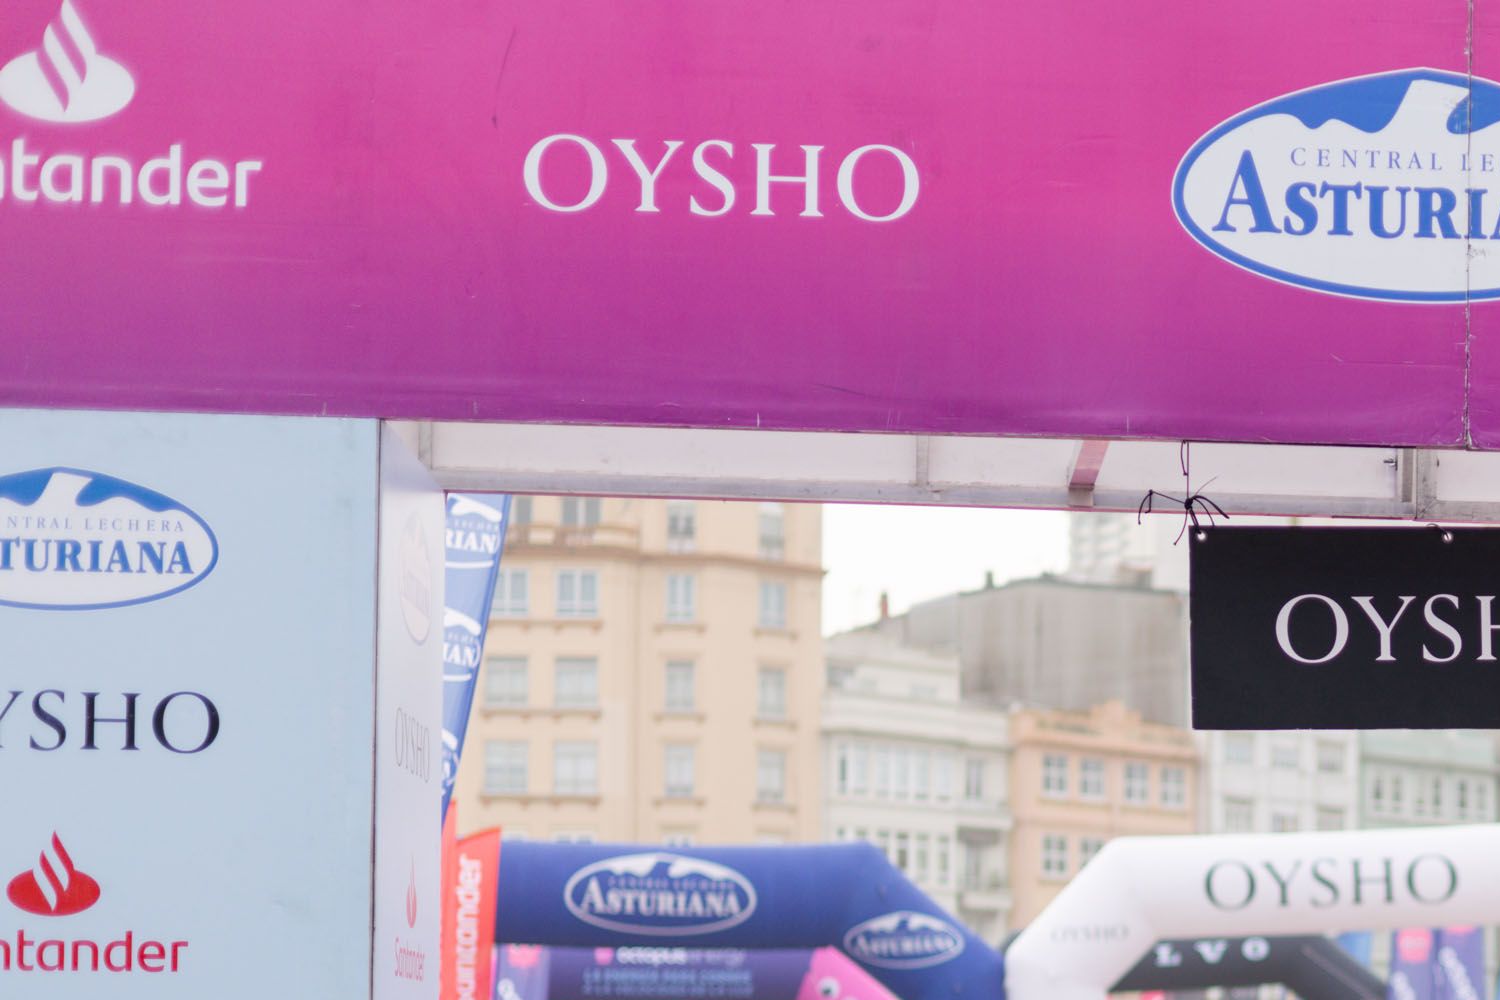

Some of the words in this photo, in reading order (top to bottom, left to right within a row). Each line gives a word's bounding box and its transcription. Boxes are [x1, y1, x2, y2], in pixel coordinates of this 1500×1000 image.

[0, 138, 262, 207] tander
[523, 133, 920, 222] OYSHO
[1290, 146, 1443, 171] CENTRAL
[83, 516, 185, 533] LECHERA
[394, 706, 432, 784] OYSHO
[579, 875, 743, 918] ASTURIANA
[1204, 854, 1459, 911] OYSHO
